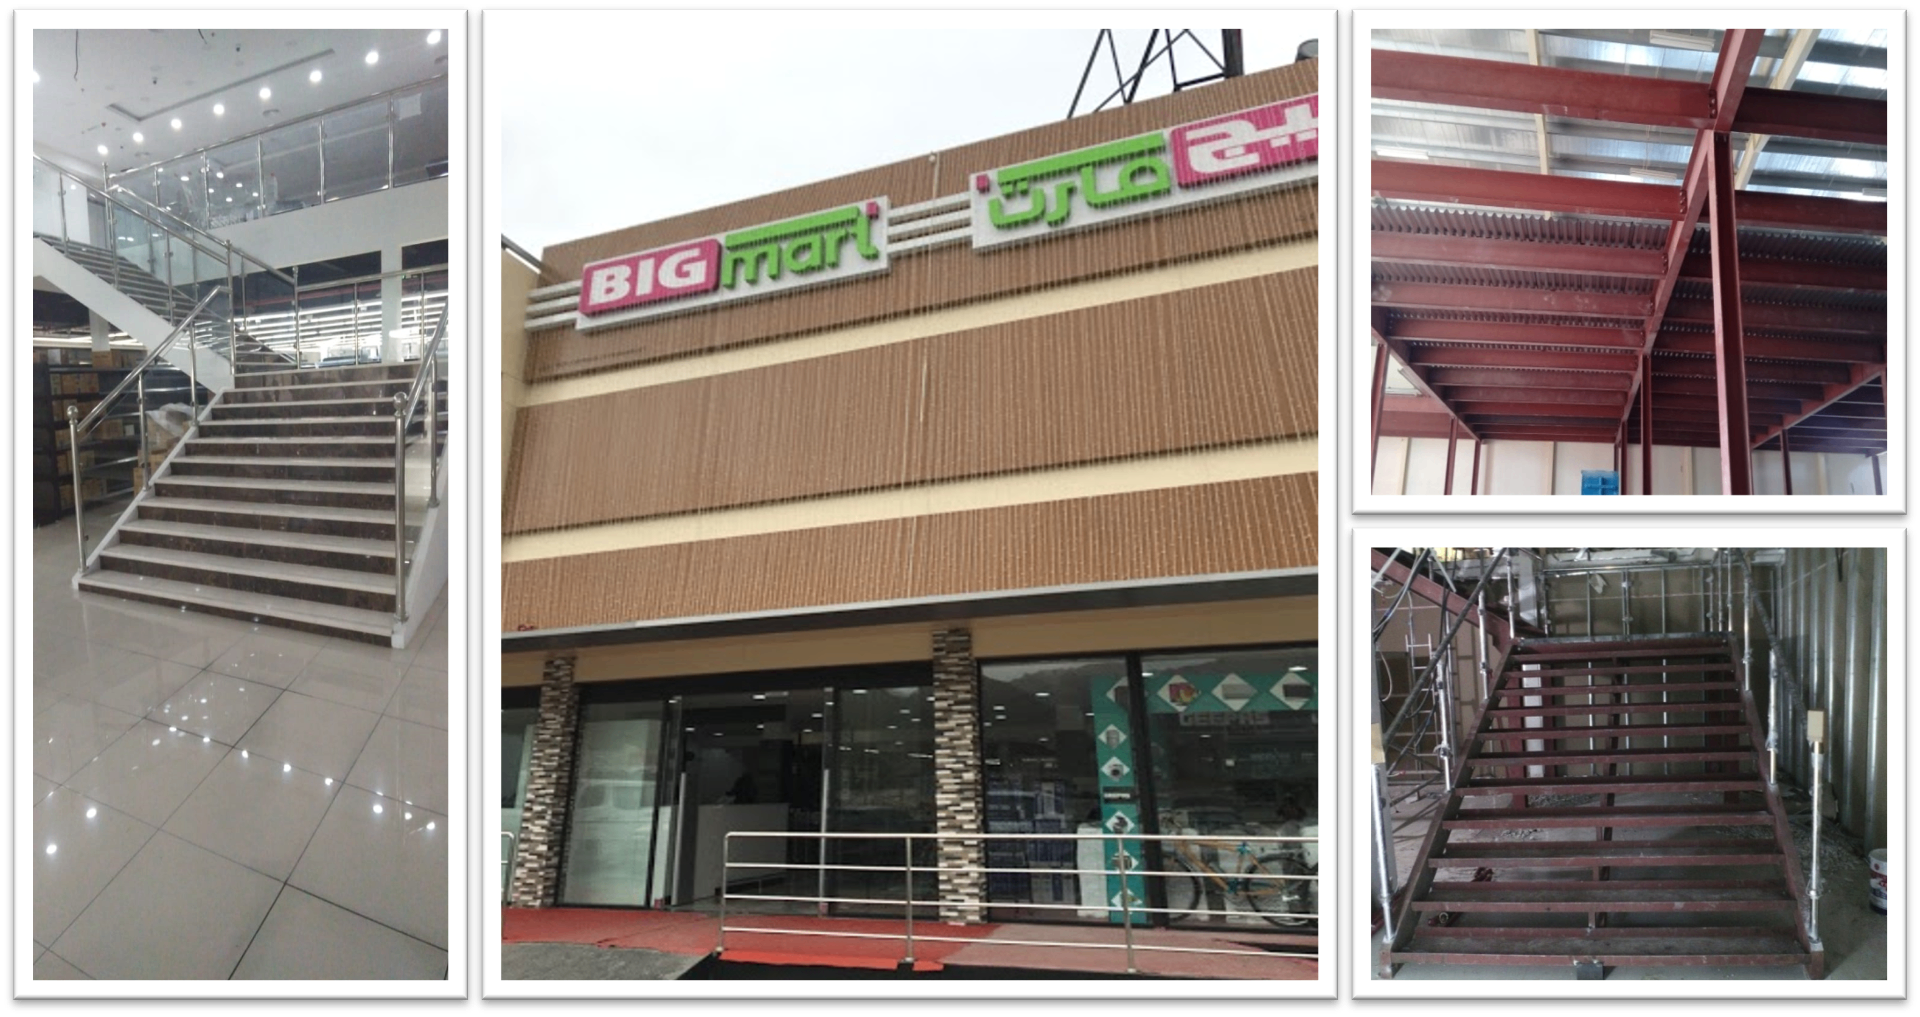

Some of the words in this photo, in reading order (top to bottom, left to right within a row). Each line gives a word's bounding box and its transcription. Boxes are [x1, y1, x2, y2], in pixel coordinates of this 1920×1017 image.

[987, 132, 1172, 229] مارت
[589, 247, 708, 306] BIG
[720, 203, 880, 289] mart
